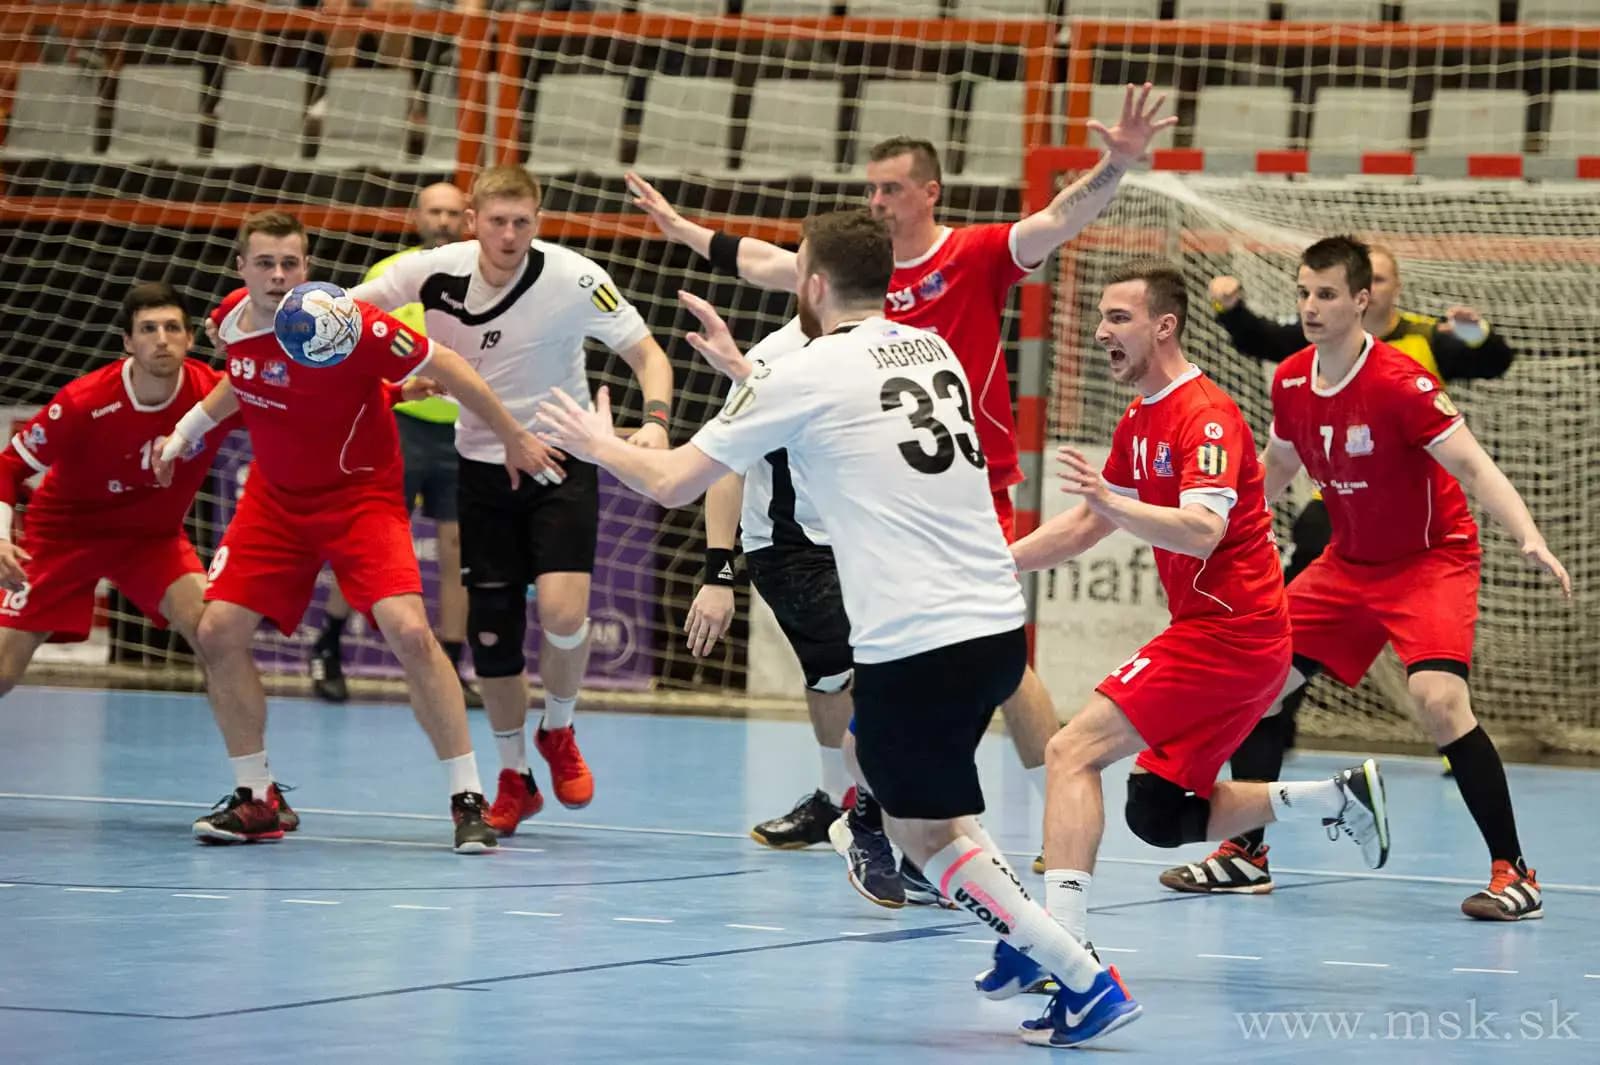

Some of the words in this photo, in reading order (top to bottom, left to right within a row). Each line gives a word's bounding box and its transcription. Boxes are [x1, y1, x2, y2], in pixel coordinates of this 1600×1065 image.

[479, 330, 501, 350] 19
[880, 370, 985, 474] 33
[1132, 435, 1149, 480] 21
[1319, 425, 1334, 463] 7
